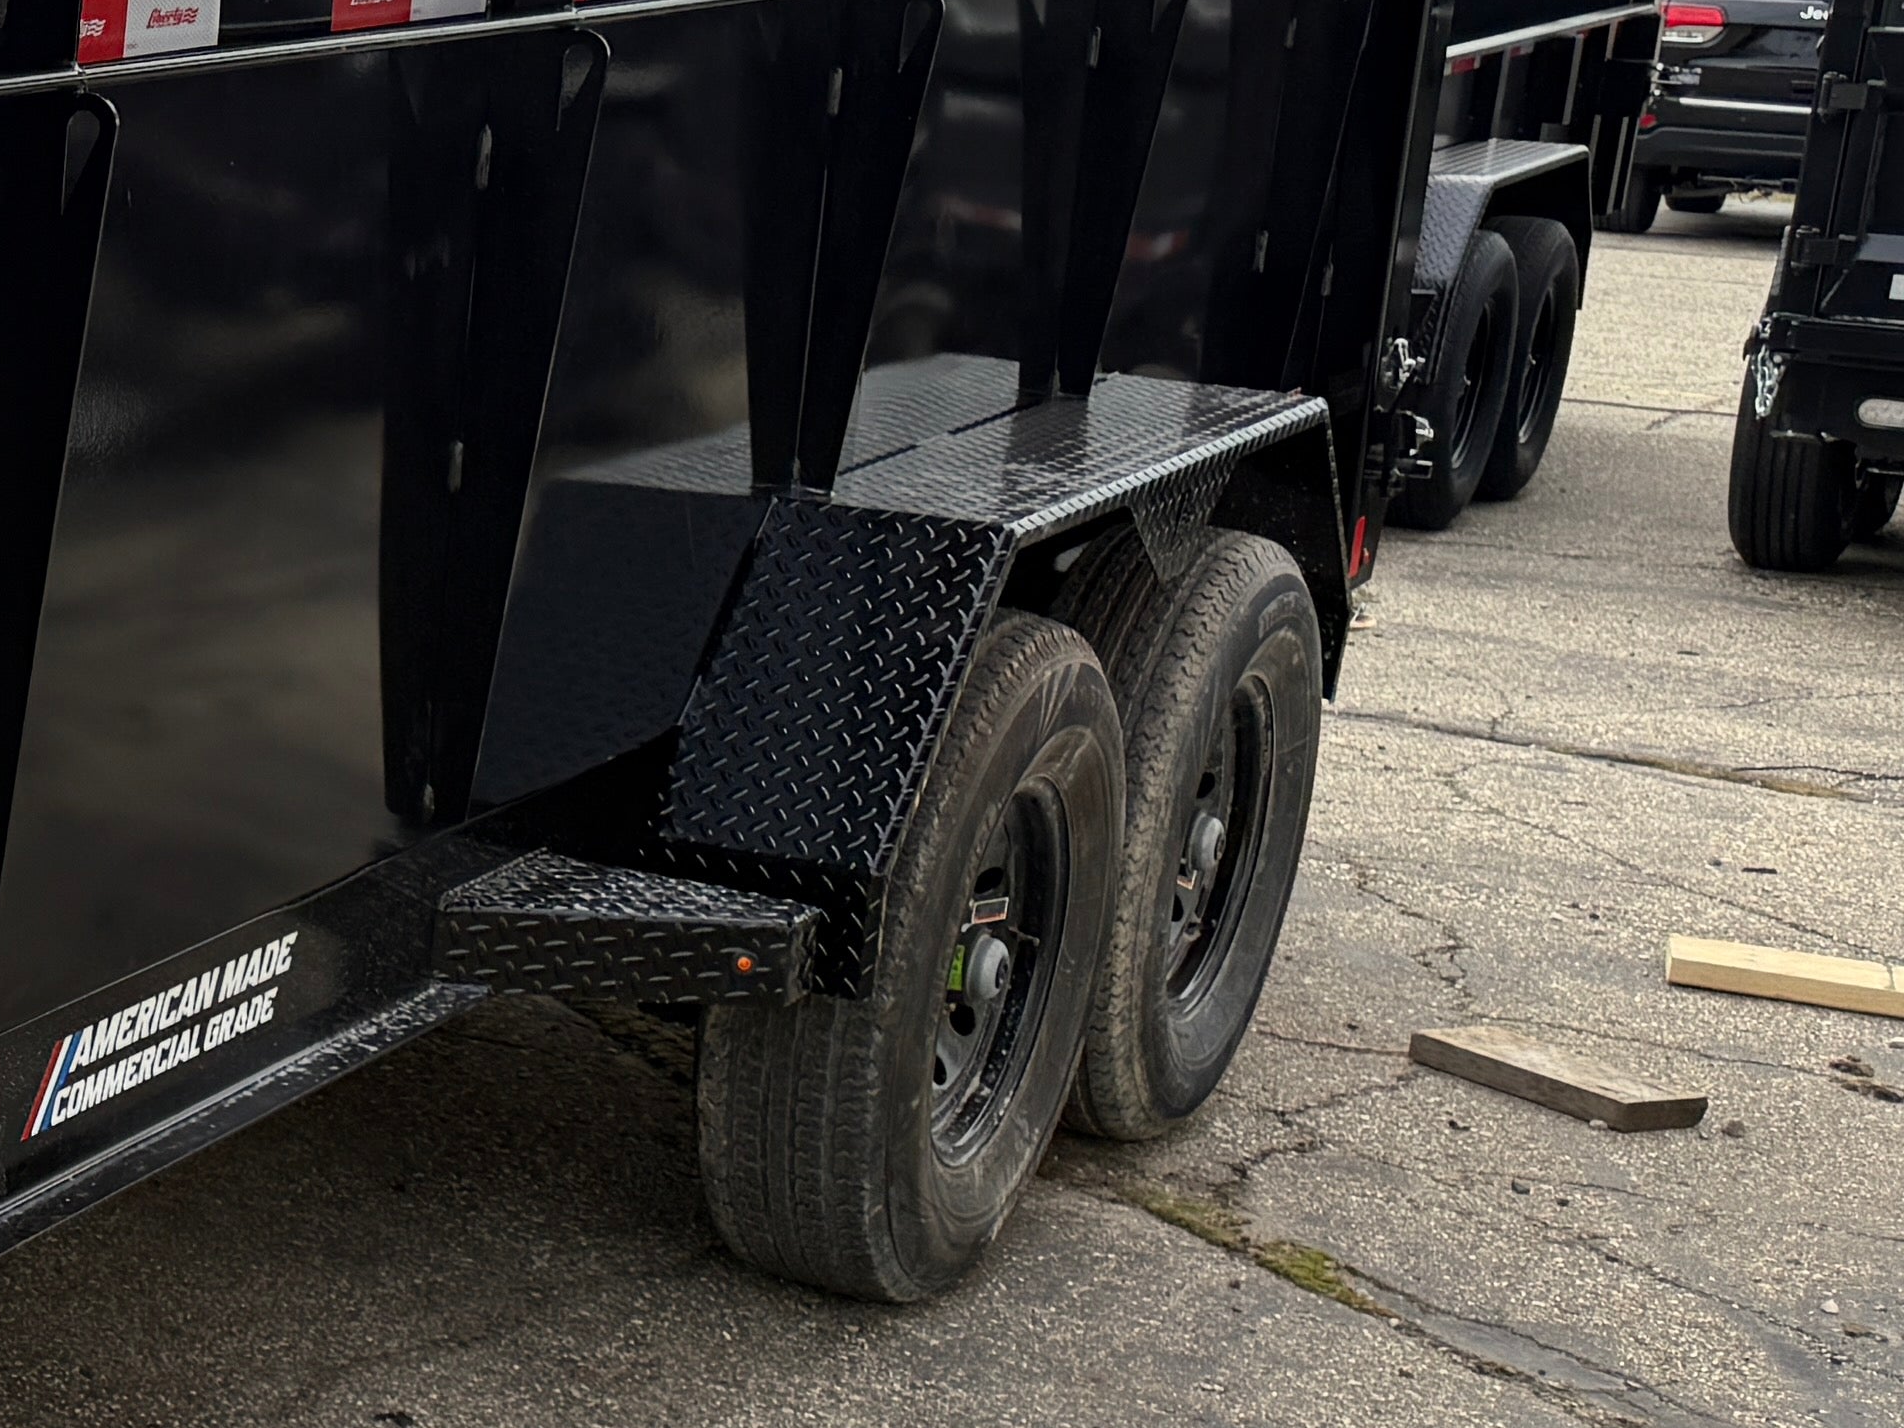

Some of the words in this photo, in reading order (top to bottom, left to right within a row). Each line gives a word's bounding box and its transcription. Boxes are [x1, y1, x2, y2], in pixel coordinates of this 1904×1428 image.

[1800, 6, 1829, 20] Je
[50, 1024, 201, 1126] COMMERCIAL
[203, 986, 279, 1052] GRADE
[69, 966, 220, 1073] AMERICAN
[218, 931, 298, 1003] MADE
